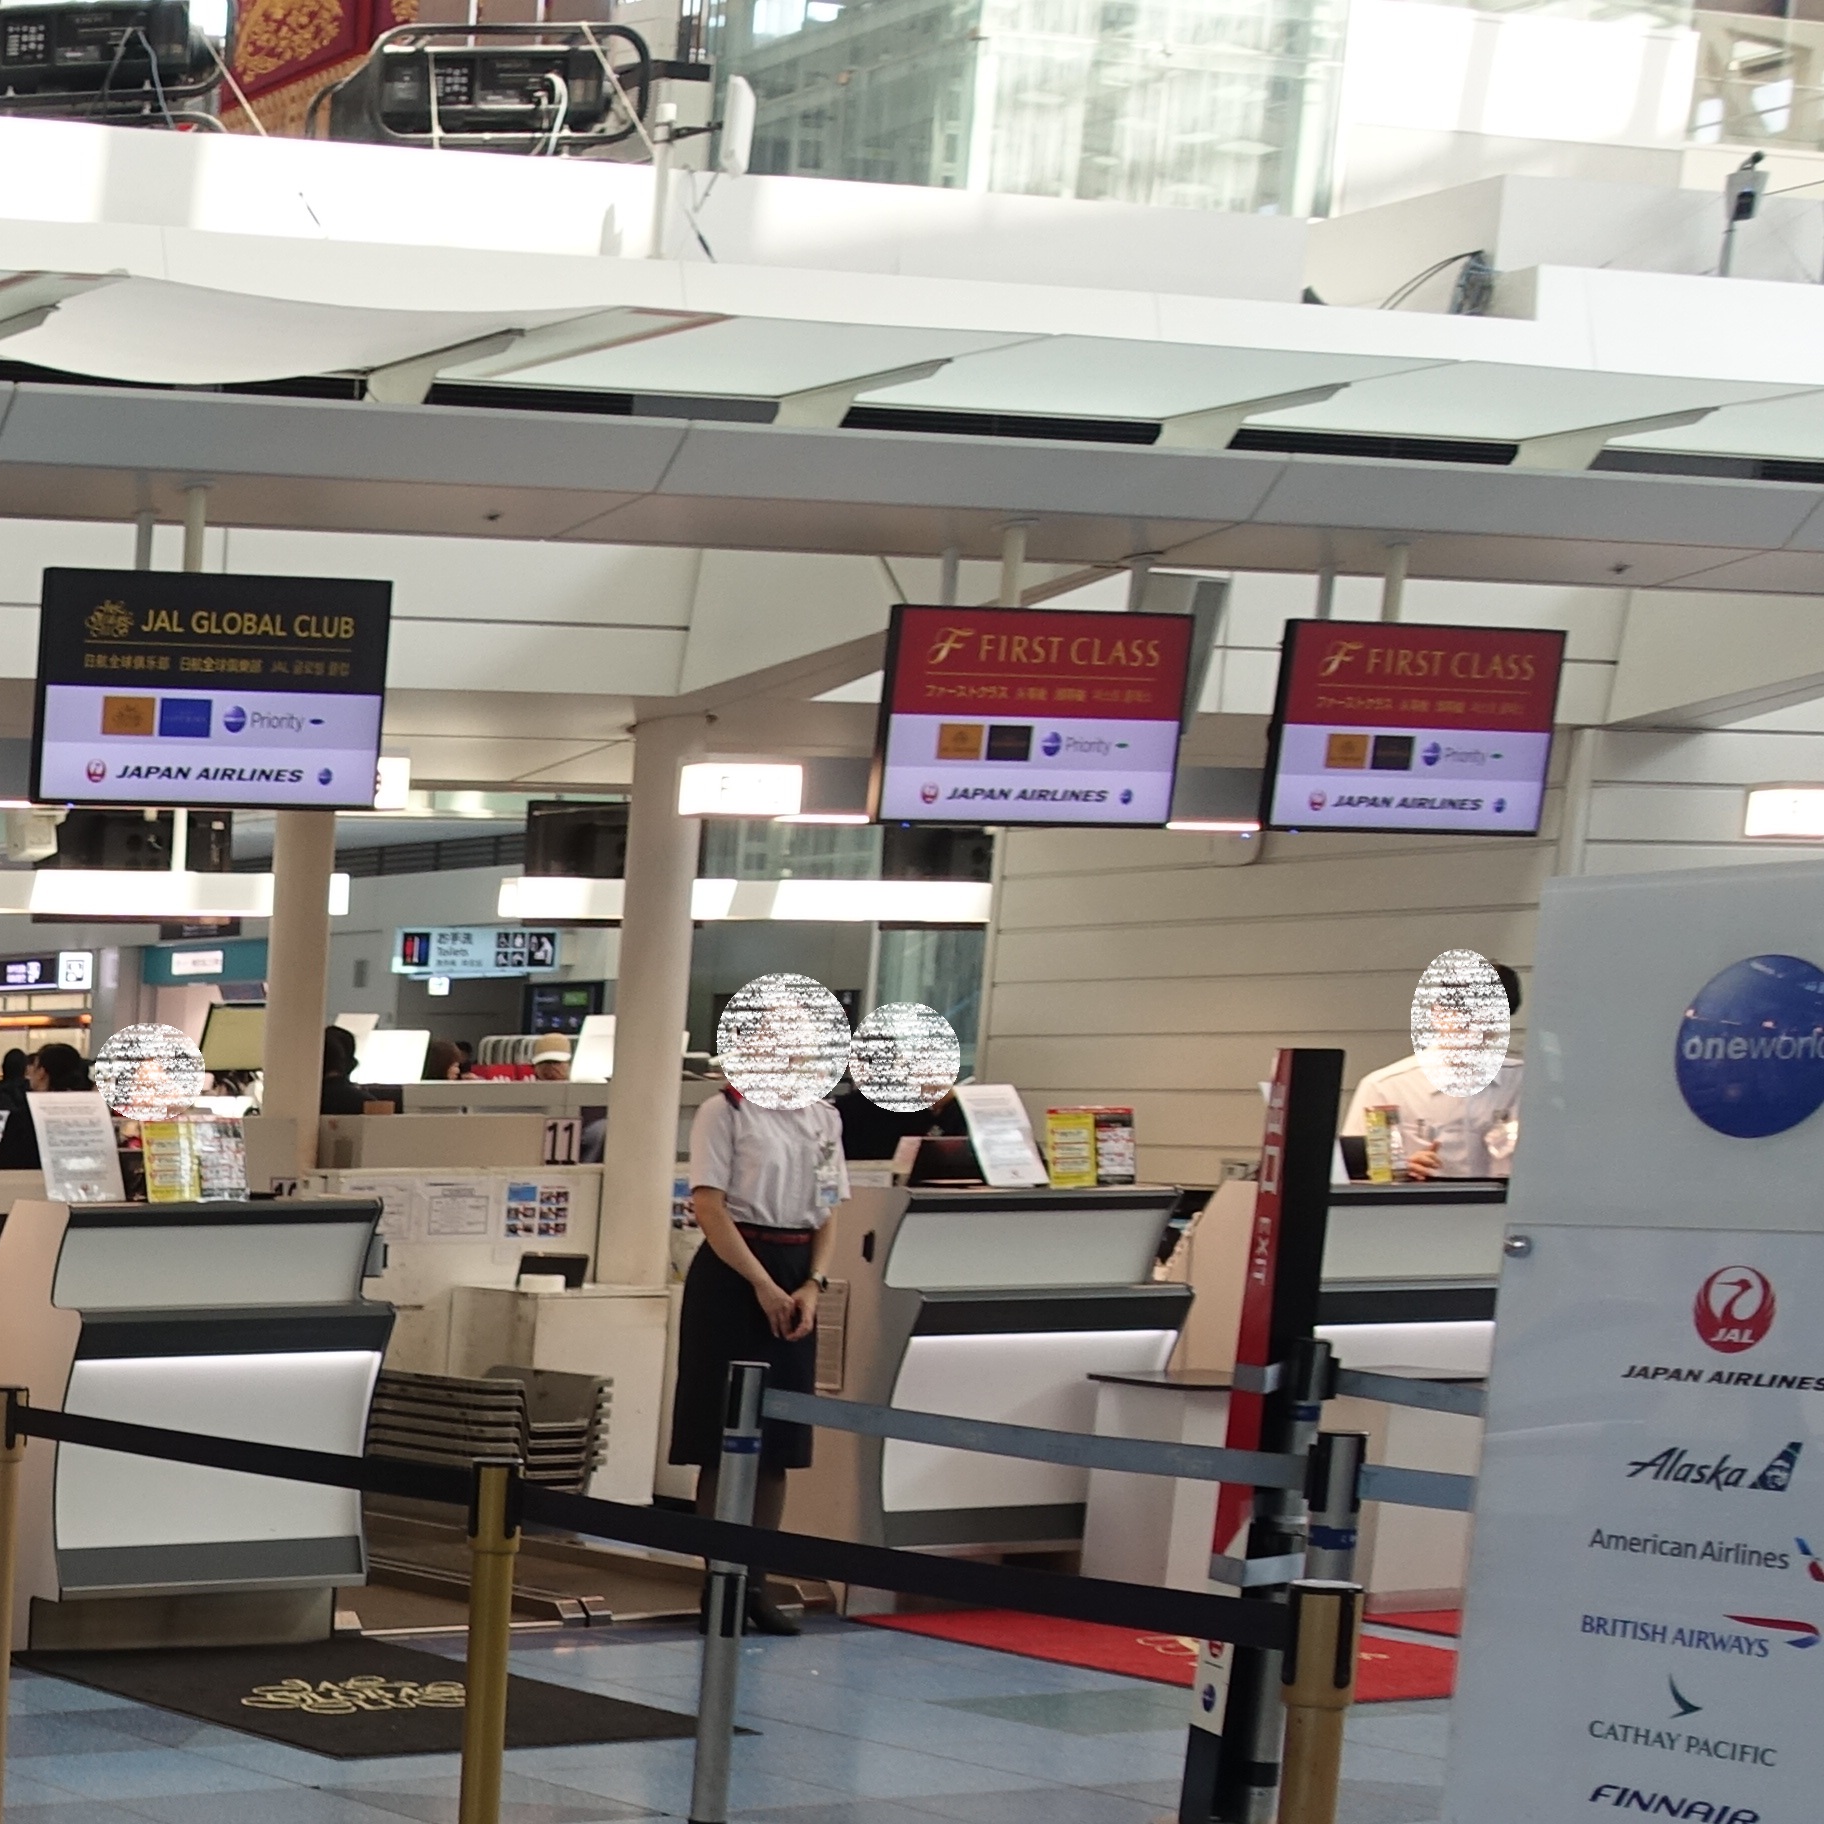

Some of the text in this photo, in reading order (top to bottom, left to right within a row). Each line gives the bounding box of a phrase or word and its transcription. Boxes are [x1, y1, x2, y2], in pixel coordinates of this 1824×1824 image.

[141, 609, 184, 633] JAL
[190, 611, 287, 637] GLOBAL
[293, 614, 355, 639] CLUB
[979, 634, 1160, 667] FIRST CLASS
[1366, 648, 1536, 681] FIRST CLASS
[250, 711, 303, 732] Priority
[116, 765, 304, 783] JAPAN AIRLINES
[947, 786, 1109, 803] JAPAN AIRLINES
[1332, 795, 1484, 811] JAPAN AIRLINES
[546, 1121, 578, 1166] 11
[1251, 1215, 1272, 1287] EXIT
[1710, 1327, 1755, 1345] JAL
[1621, 1363, 1824, 1393] JAPAN AIRLINES
[1627, 1446, 1748, 1491] Alaska
[1589, 1528, 1790, 1571] American Airlines
[1580, 1614, 1770, 1658] BRITISH AIRWAYS
[1588, 1719, 1778, 1767] CATHAY PACIFIC
